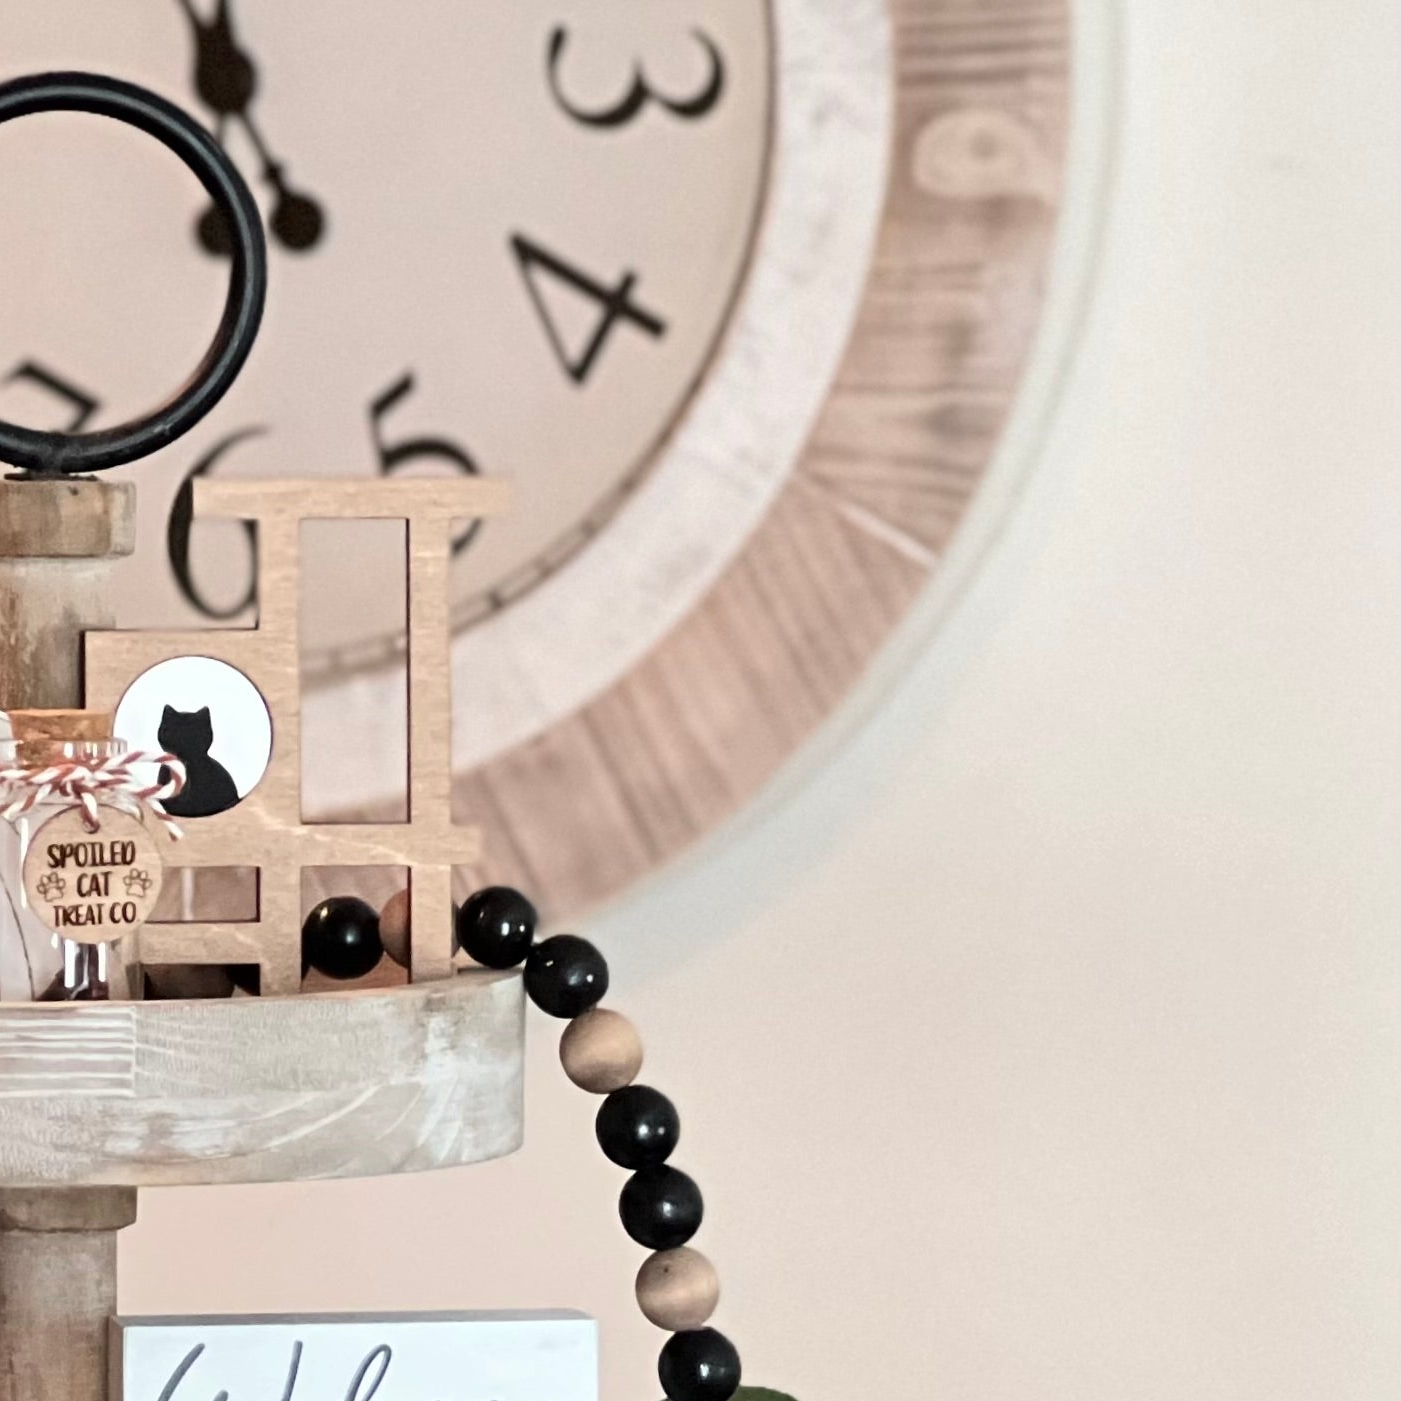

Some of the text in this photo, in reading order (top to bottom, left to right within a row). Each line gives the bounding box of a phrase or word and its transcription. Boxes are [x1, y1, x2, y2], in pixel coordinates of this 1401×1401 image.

[547, 24, 725, 132] 3
[508, 230, 666, 384] 4
[47, 840, 136, 868] SPOILED
[76, 871, 113, 897] CAT
[53, 903, 105, 927] TREAT
